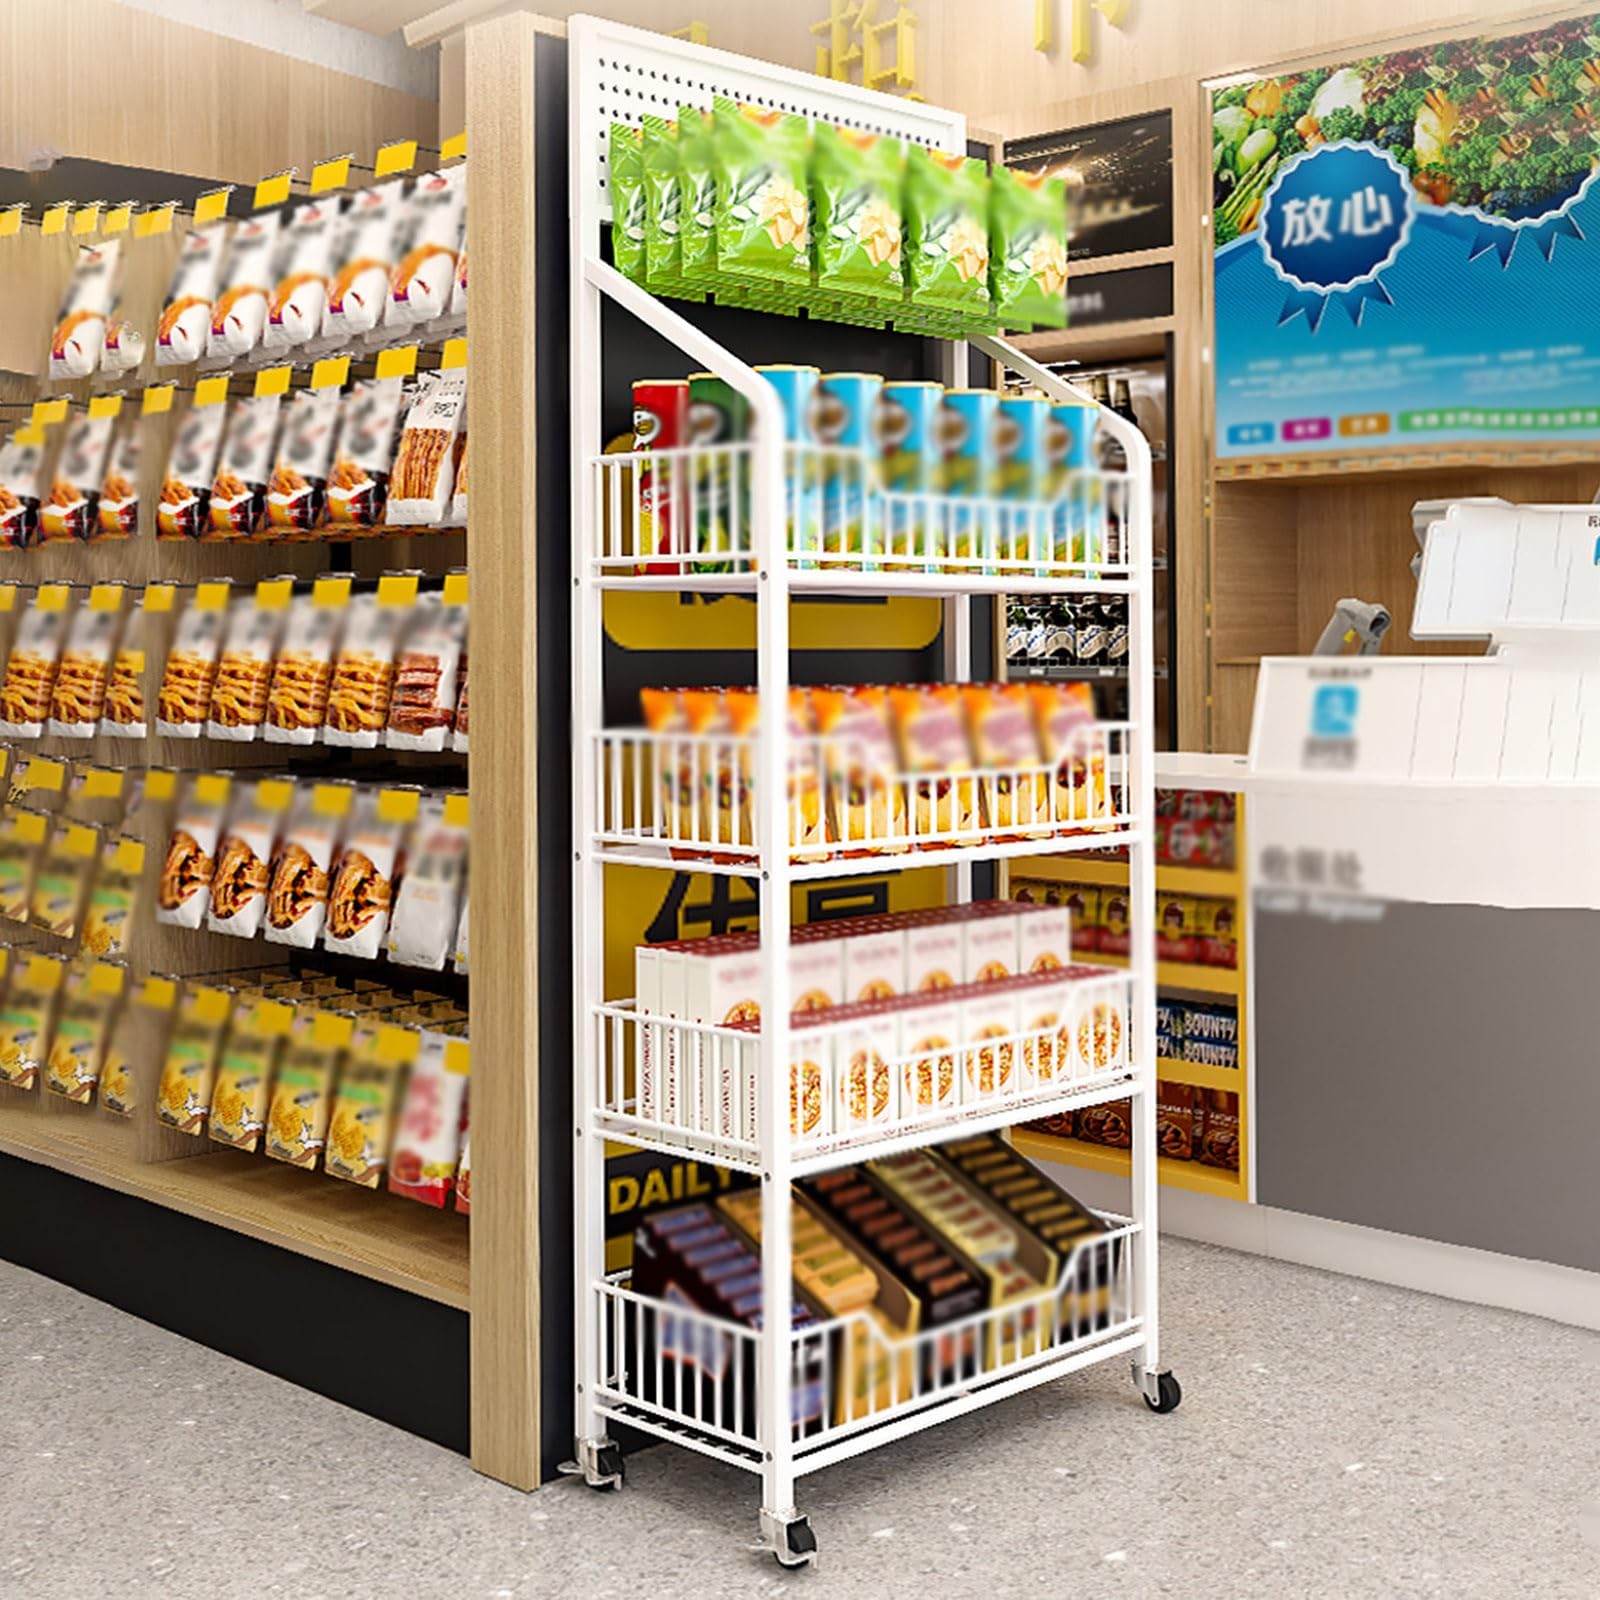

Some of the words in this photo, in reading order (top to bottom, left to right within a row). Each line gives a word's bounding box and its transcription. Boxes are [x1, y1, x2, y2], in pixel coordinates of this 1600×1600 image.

[1281, 185, 1393, 248] 放心
[1183, 1011, 1237, 1041] BOUNTY
[1183, 1038, 1236, 1068] BOUNTY
[608, 1163, 732, 1216] DAILY
